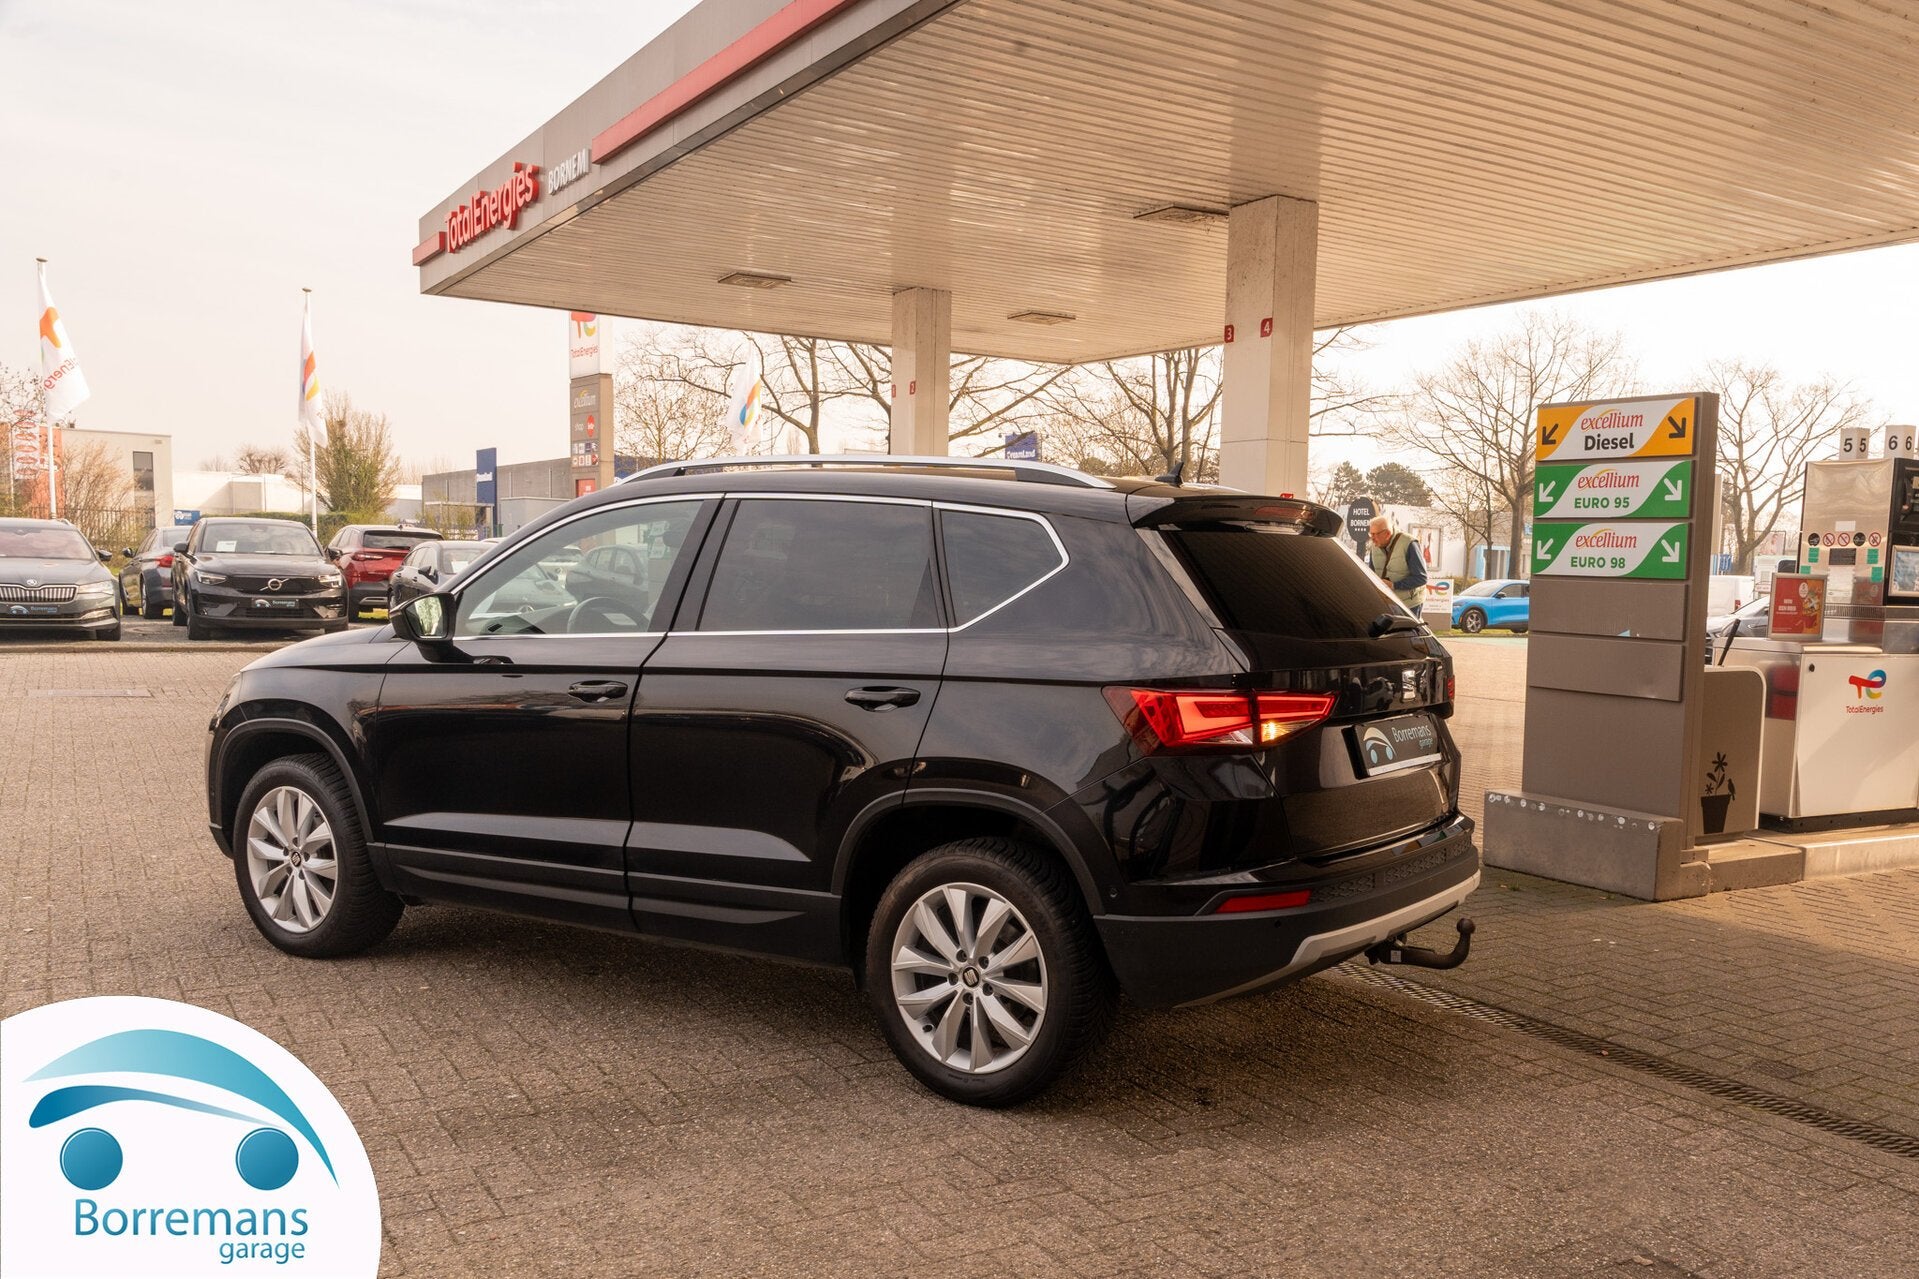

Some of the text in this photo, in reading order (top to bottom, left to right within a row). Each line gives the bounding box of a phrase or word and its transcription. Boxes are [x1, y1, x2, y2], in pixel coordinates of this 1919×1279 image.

[445, 148, 592, 253] TotalEnergies BORNEM
[1227, 327, 1232, 341] 3
[1264, 321, 1271, 334] 4
[1580, 412, 1643, 430] excellium
[1584, 433, 1634, 451] Diesel
[1843, 438, 1867, 453] 5 5
[1888, 435, 1913, 451] 6 6
[1577, 473, 1640, 490] excellium
[1574, 497, 1630, 509] EURO 95
[1353, 508, 1370, 516] HOTEL
[1575, 532, 1637, 549] excellium
[1570, 556, 1626, 569] EURO 98
[1845, 704, 1884, 715] TotalEnergies
[1391, 725, 1432, 743] Borremans
